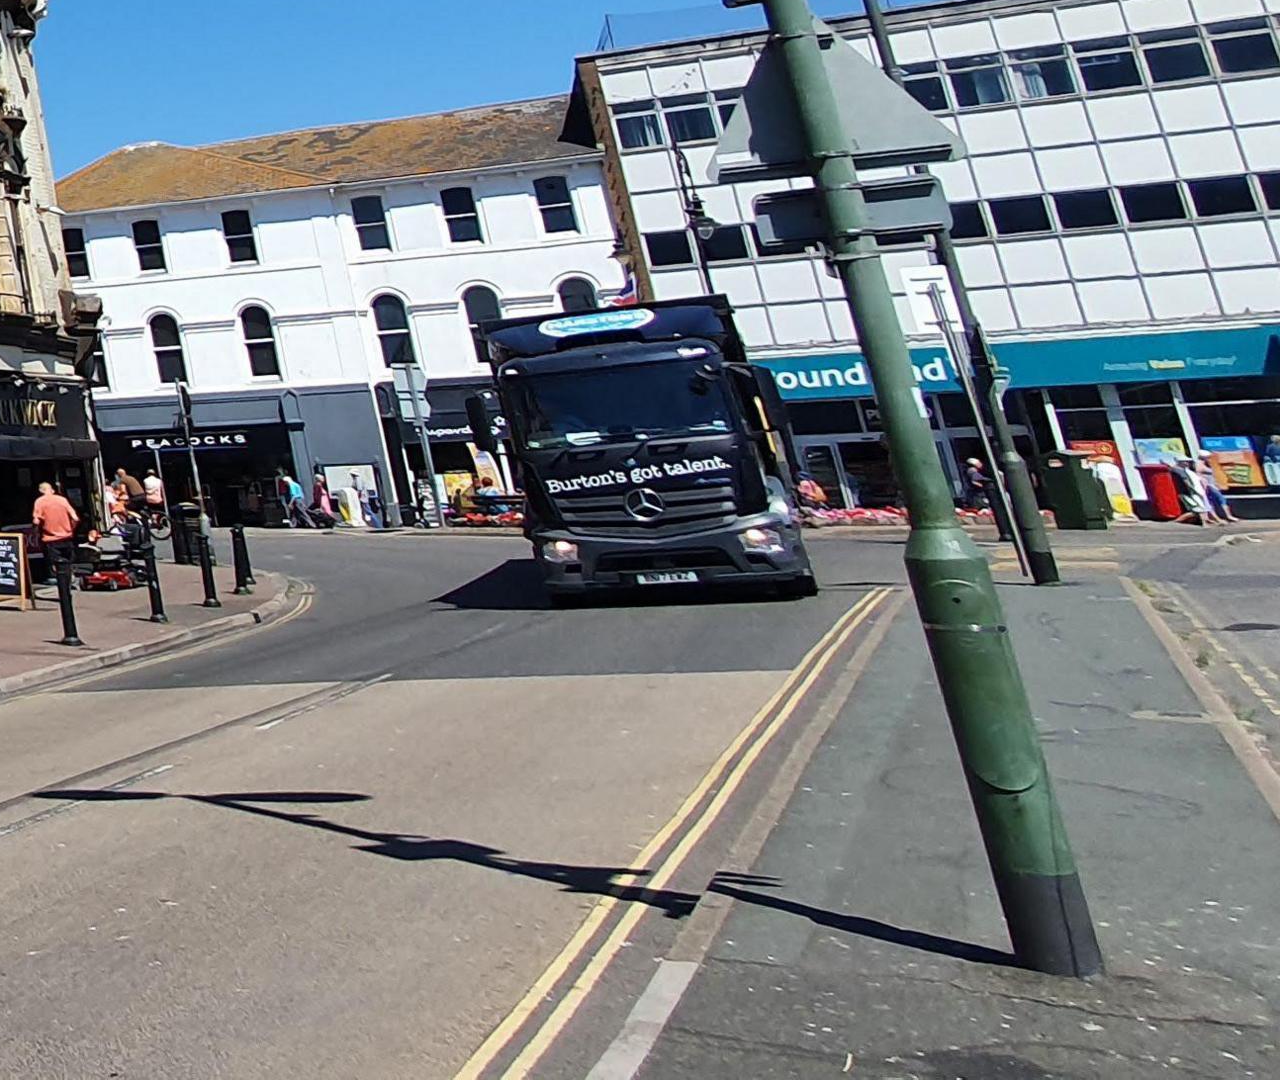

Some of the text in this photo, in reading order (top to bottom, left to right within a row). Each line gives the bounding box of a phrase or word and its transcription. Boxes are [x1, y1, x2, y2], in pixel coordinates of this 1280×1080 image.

[545, 455, 733, 494] Burton's got talent.
